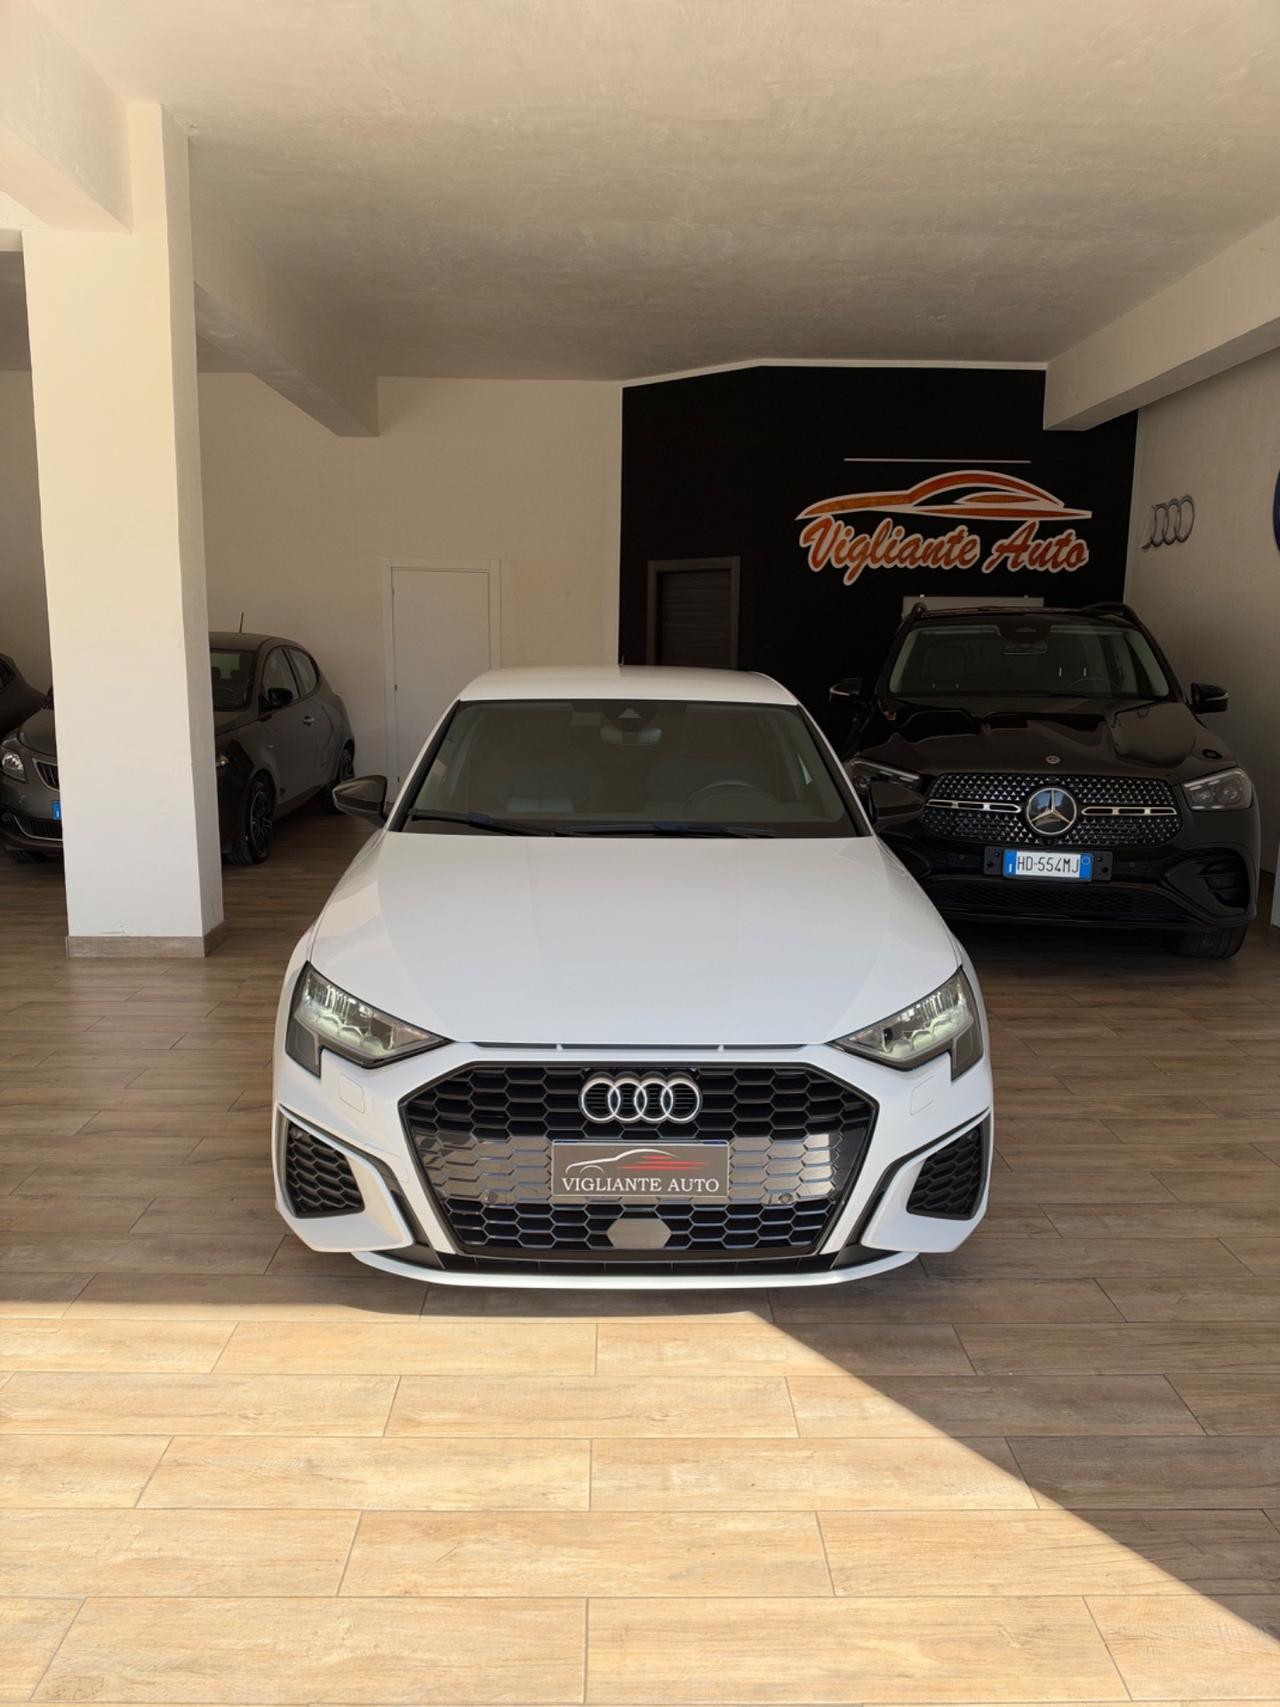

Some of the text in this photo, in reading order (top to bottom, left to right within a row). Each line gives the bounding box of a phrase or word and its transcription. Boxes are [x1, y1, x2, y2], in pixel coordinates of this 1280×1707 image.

[800, 514, 1090, 586] Vigliante Auto
[562, 1177, 720, 1193] VIGLIANTE AUTO
